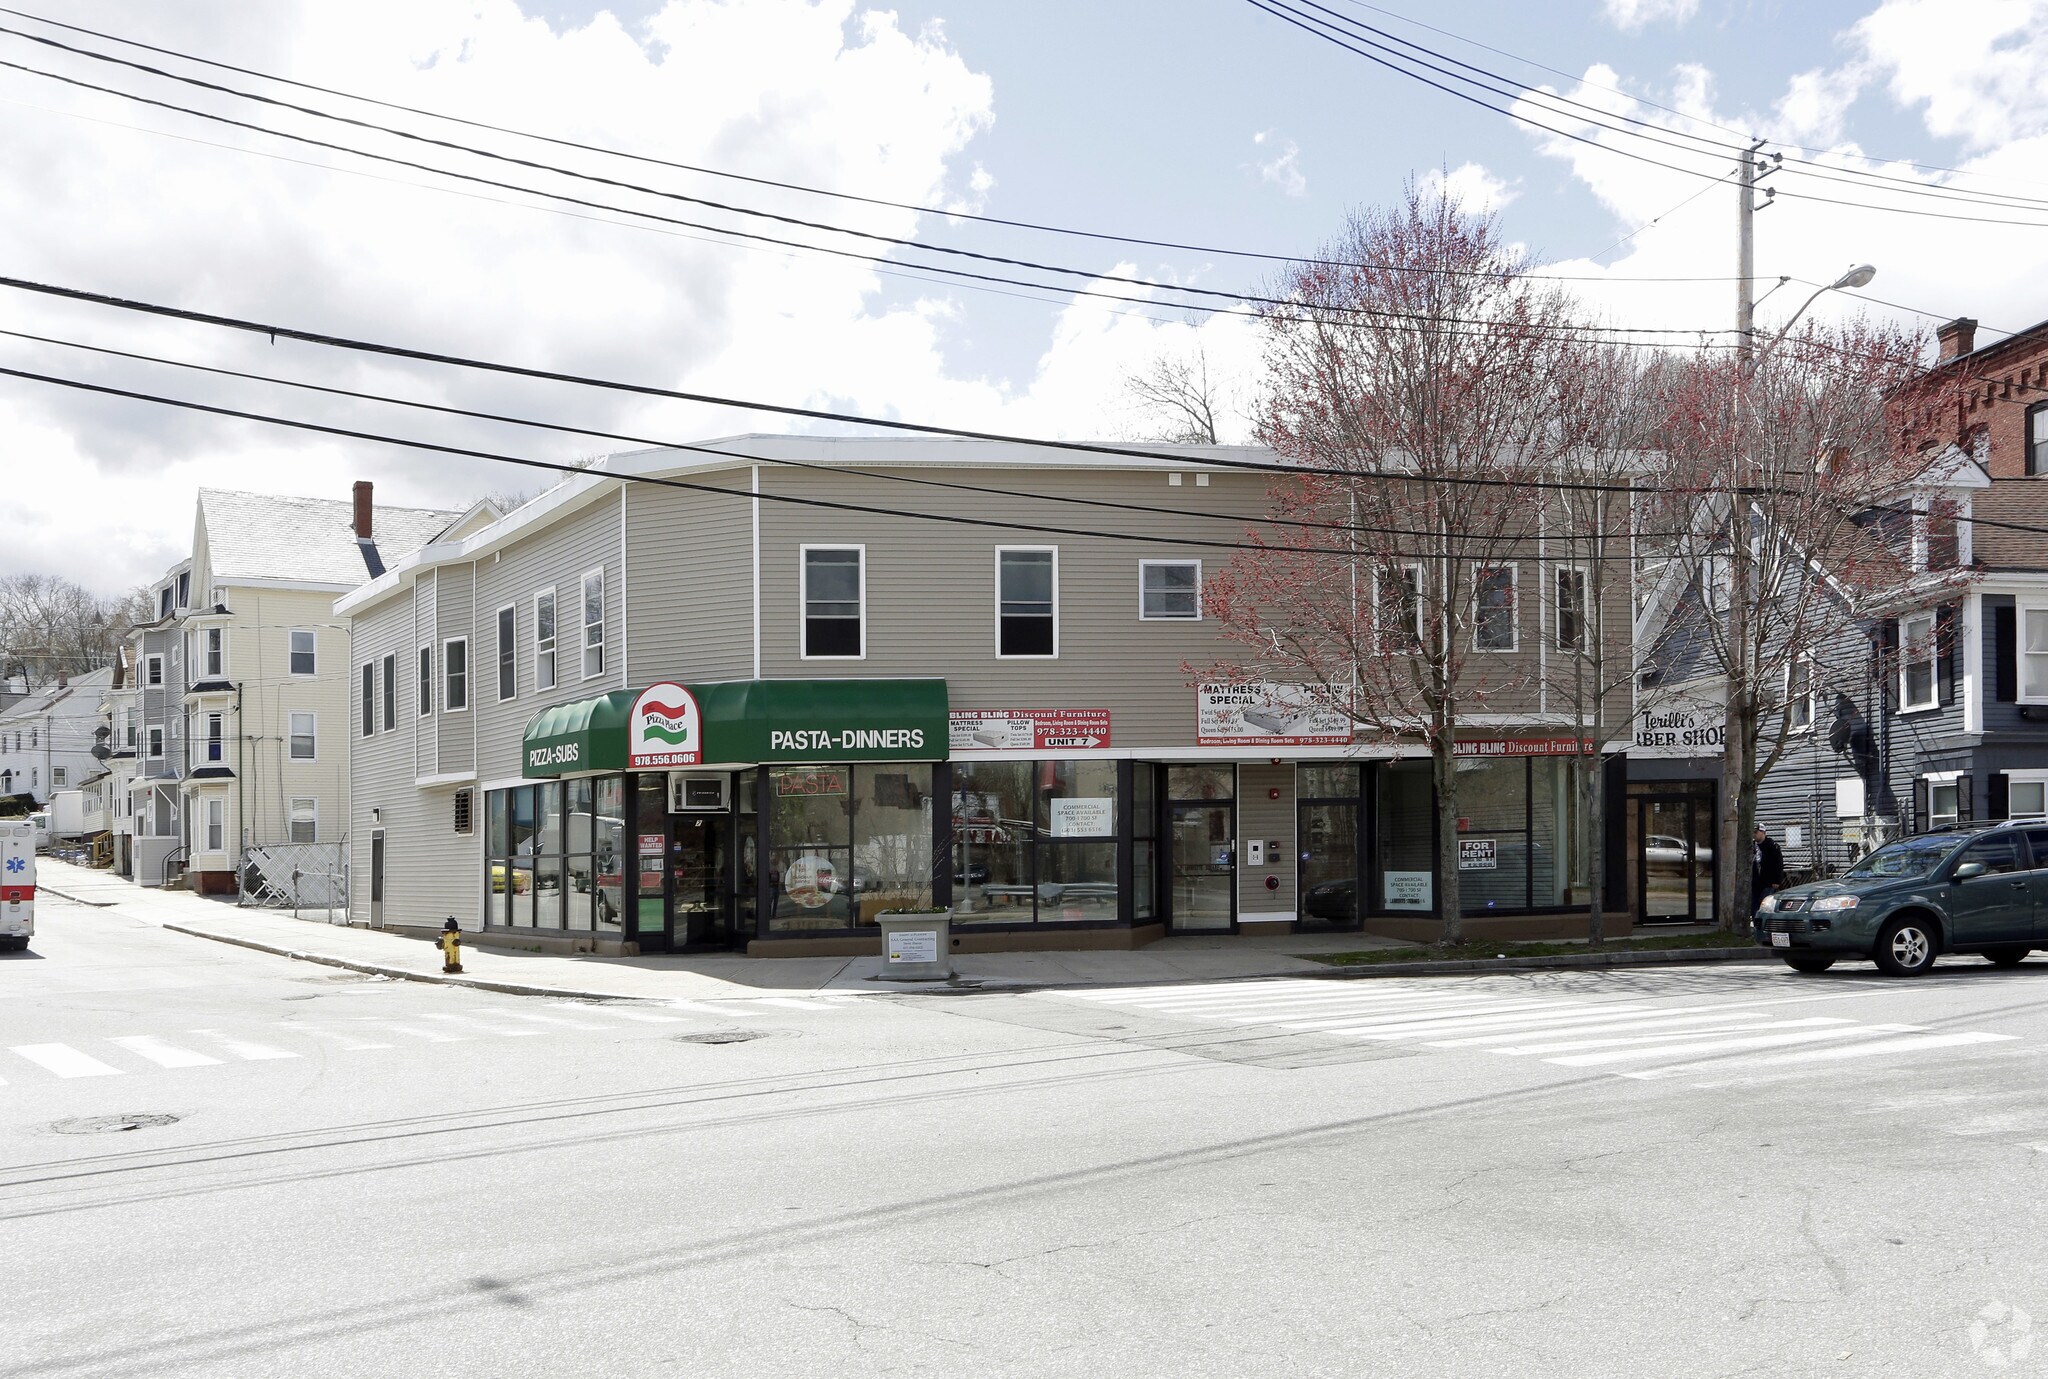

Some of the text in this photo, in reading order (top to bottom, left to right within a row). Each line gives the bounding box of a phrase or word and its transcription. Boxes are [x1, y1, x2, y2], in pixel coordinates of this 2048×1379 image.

[1203, 685, 1261, 694] MATTRESS
[1210, 696, 1255, 705] SPECIAL
[1013, 710, 1057, 718] Discount
[1060, 710, 1107, 718] Furniture
[1037, 727, 1107, 736] 978-323-4440
[771, 729, 924, 750] PASTA-DINNERS
[1048, 738, 1088, 746] UNIT 7
[1255, 738, 1270, 746] Dining
[1480, 741, 1505, 754] BLING
[1508, 740, 1548, 753] Discount
[530, 742, 579, 767] PIZZA-SUBS
[634, 753, 695, 766] 978.556.0606
[780, 774, 843, 794] PASTA
[1465, 842, 1489, 850] FOR
[1461, 849, 1493, 858] RENT
